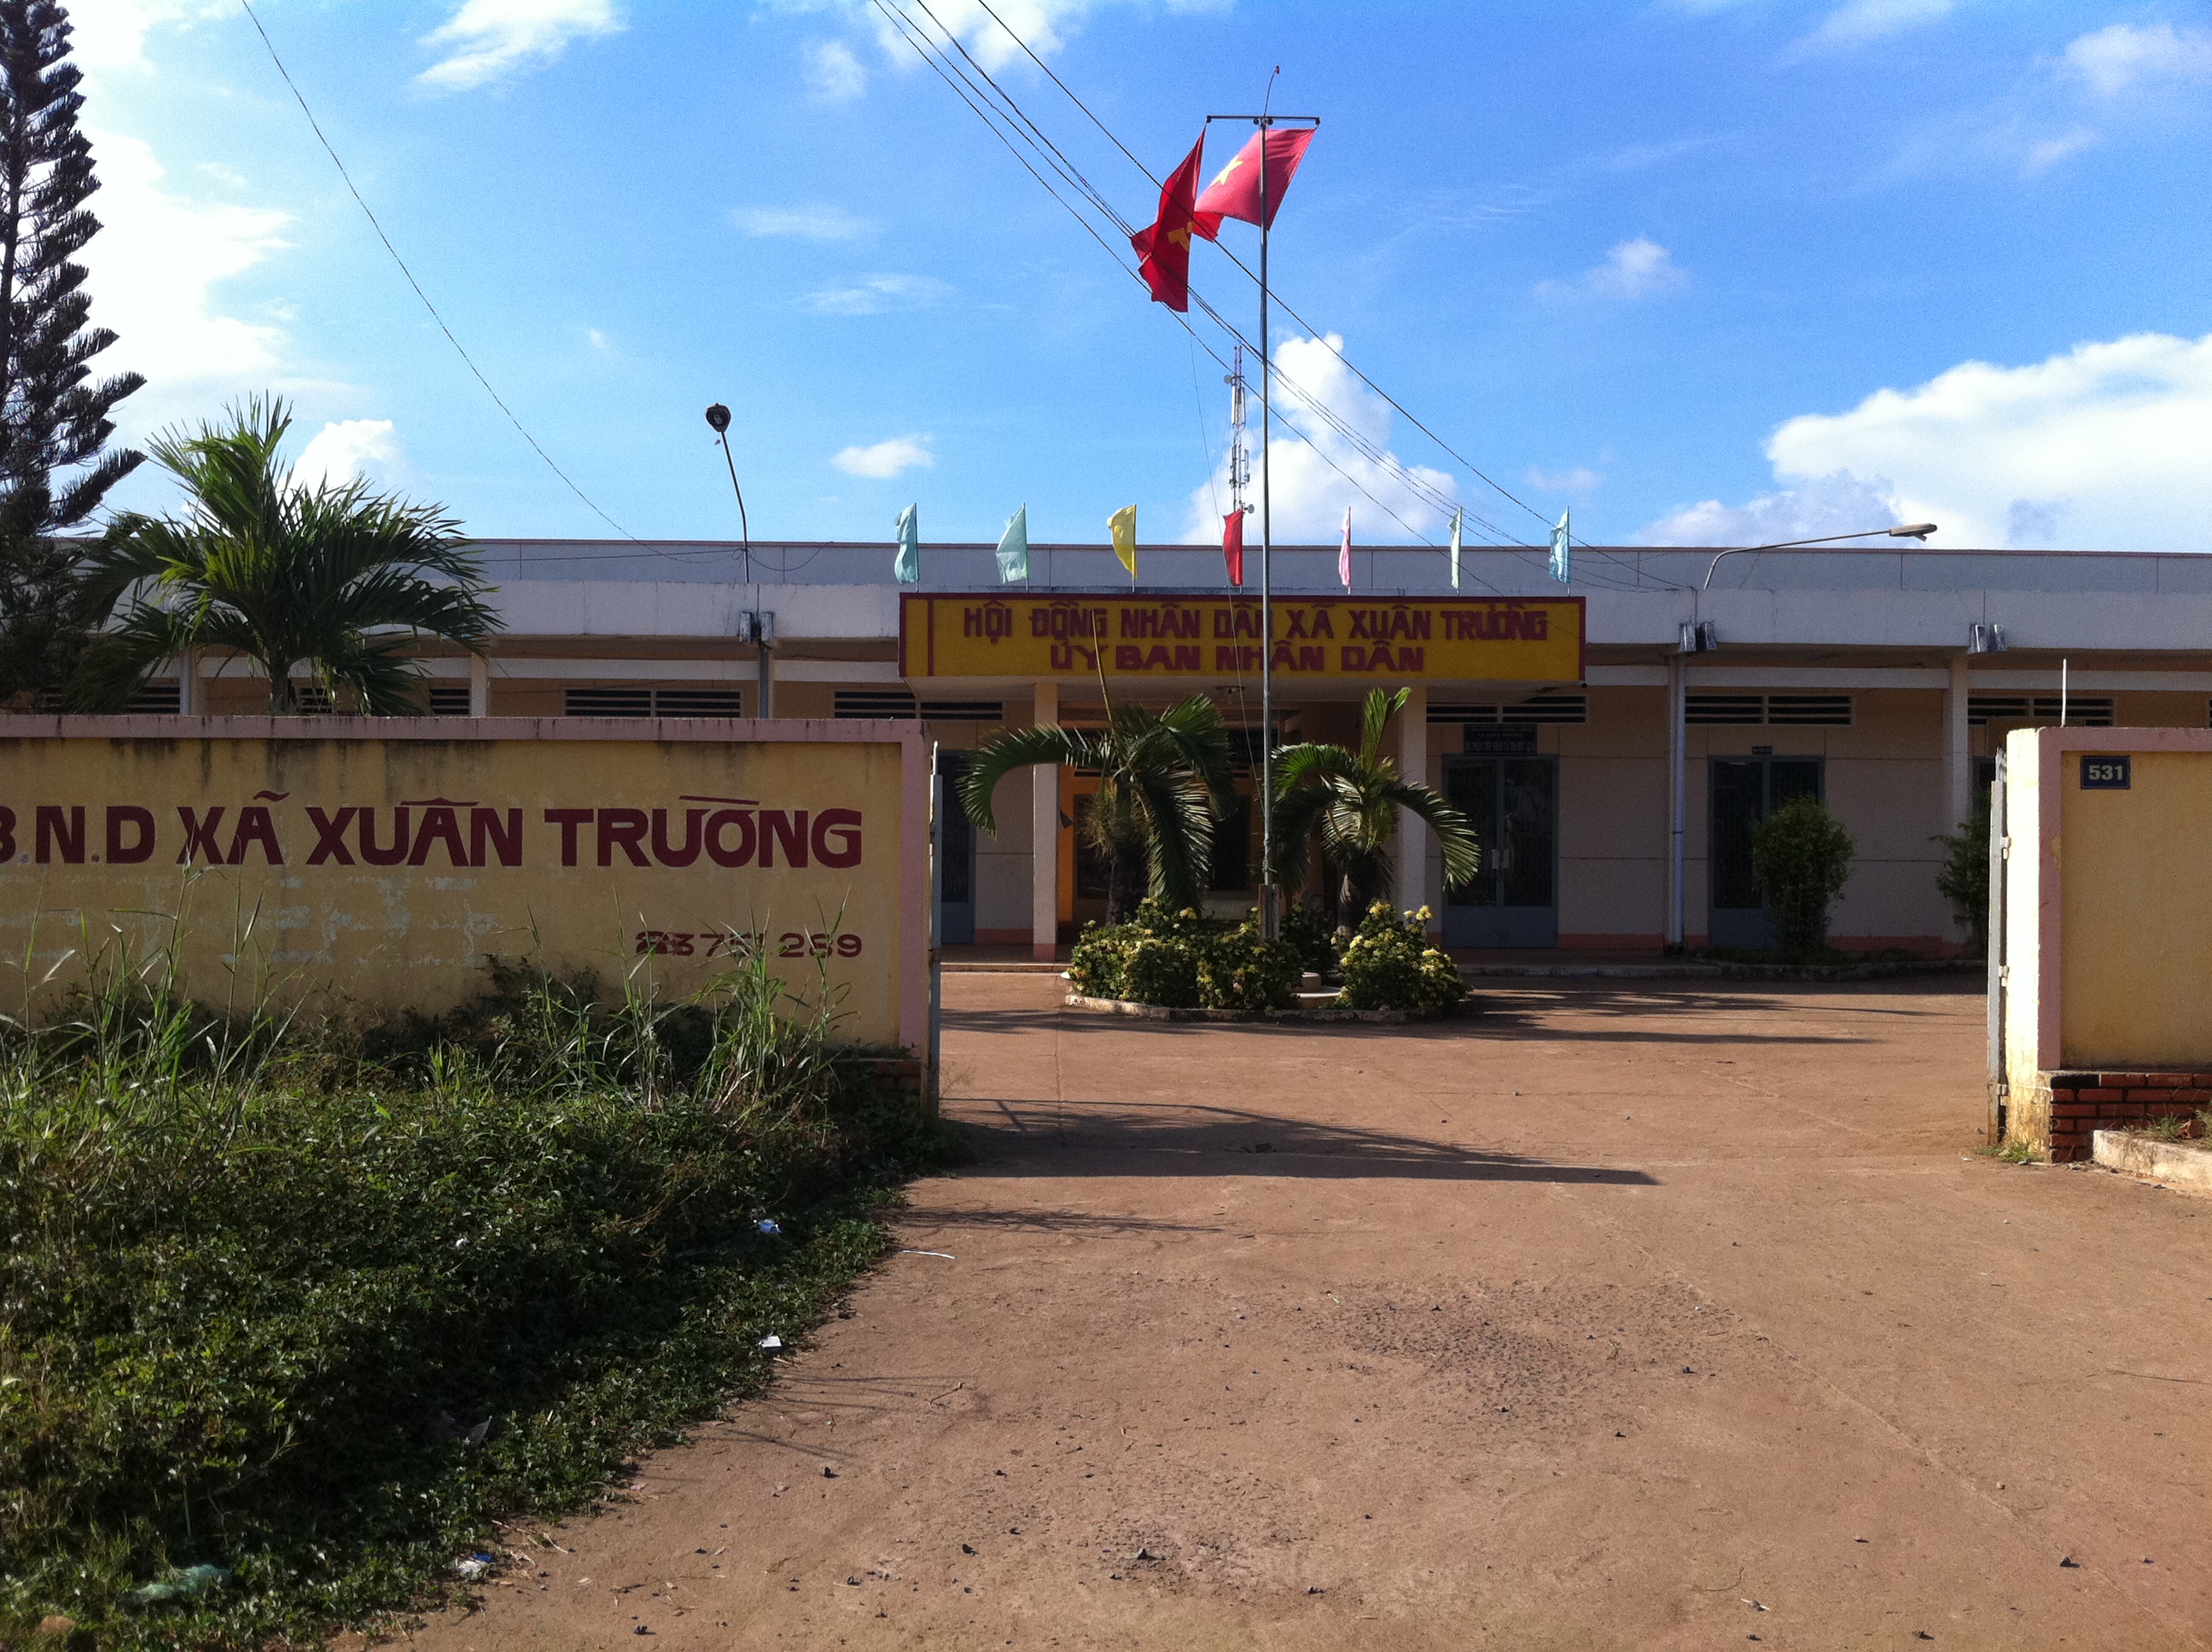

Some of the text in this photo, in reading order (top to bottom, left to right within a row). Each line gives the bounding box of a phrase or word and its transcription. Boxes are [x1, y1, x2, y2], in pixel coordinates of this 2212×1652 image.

[964, 599, 1012, 644] HỘI
[1121, 602, 1200, 638] NHÂN
[1287, 602, 1336, 639] XÃ
[1348, 604, 1431, 640] XUÂN
[1115, 644, 1200, 671] BAN
[1216, 640, 1324, 672] NHÂN
[1341, 639, 1424, 672] DÂN
[2088, 765, 2123, 781] 531
[176, 790, 290, 865] XÃ
[305, 797, 523, 867] XUÂN
[778, 933, 862, 957] 289
